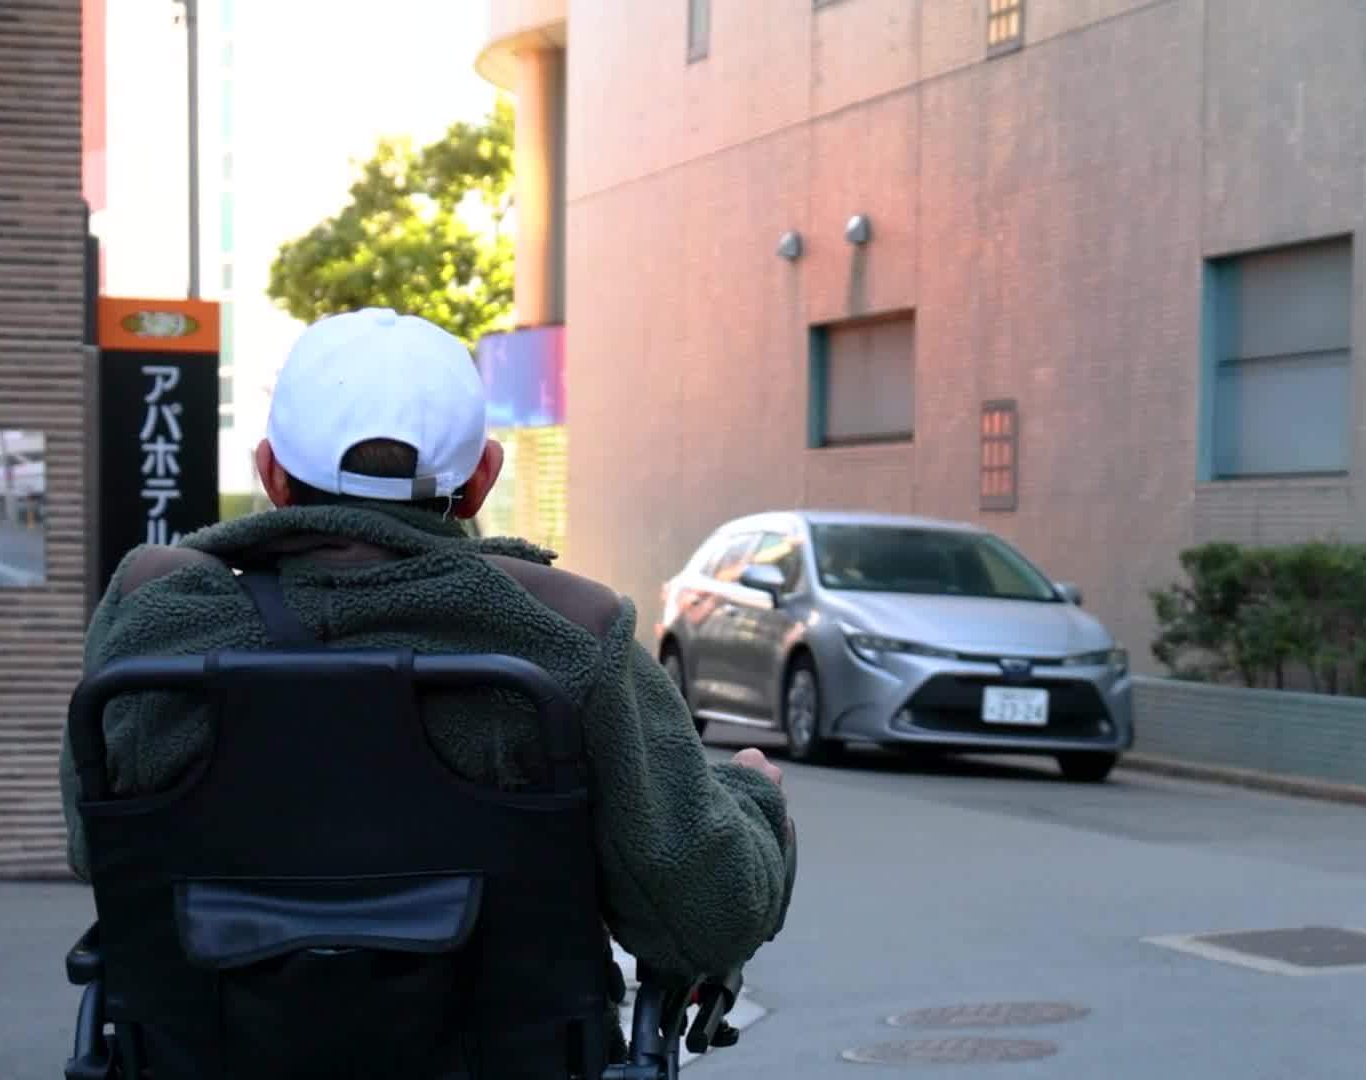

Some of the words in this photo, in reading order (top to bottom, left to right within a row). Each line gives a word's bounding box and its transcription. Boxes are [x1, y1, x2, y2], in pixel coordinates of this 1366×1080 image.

[140, 365, 183, 547] アパホテル
